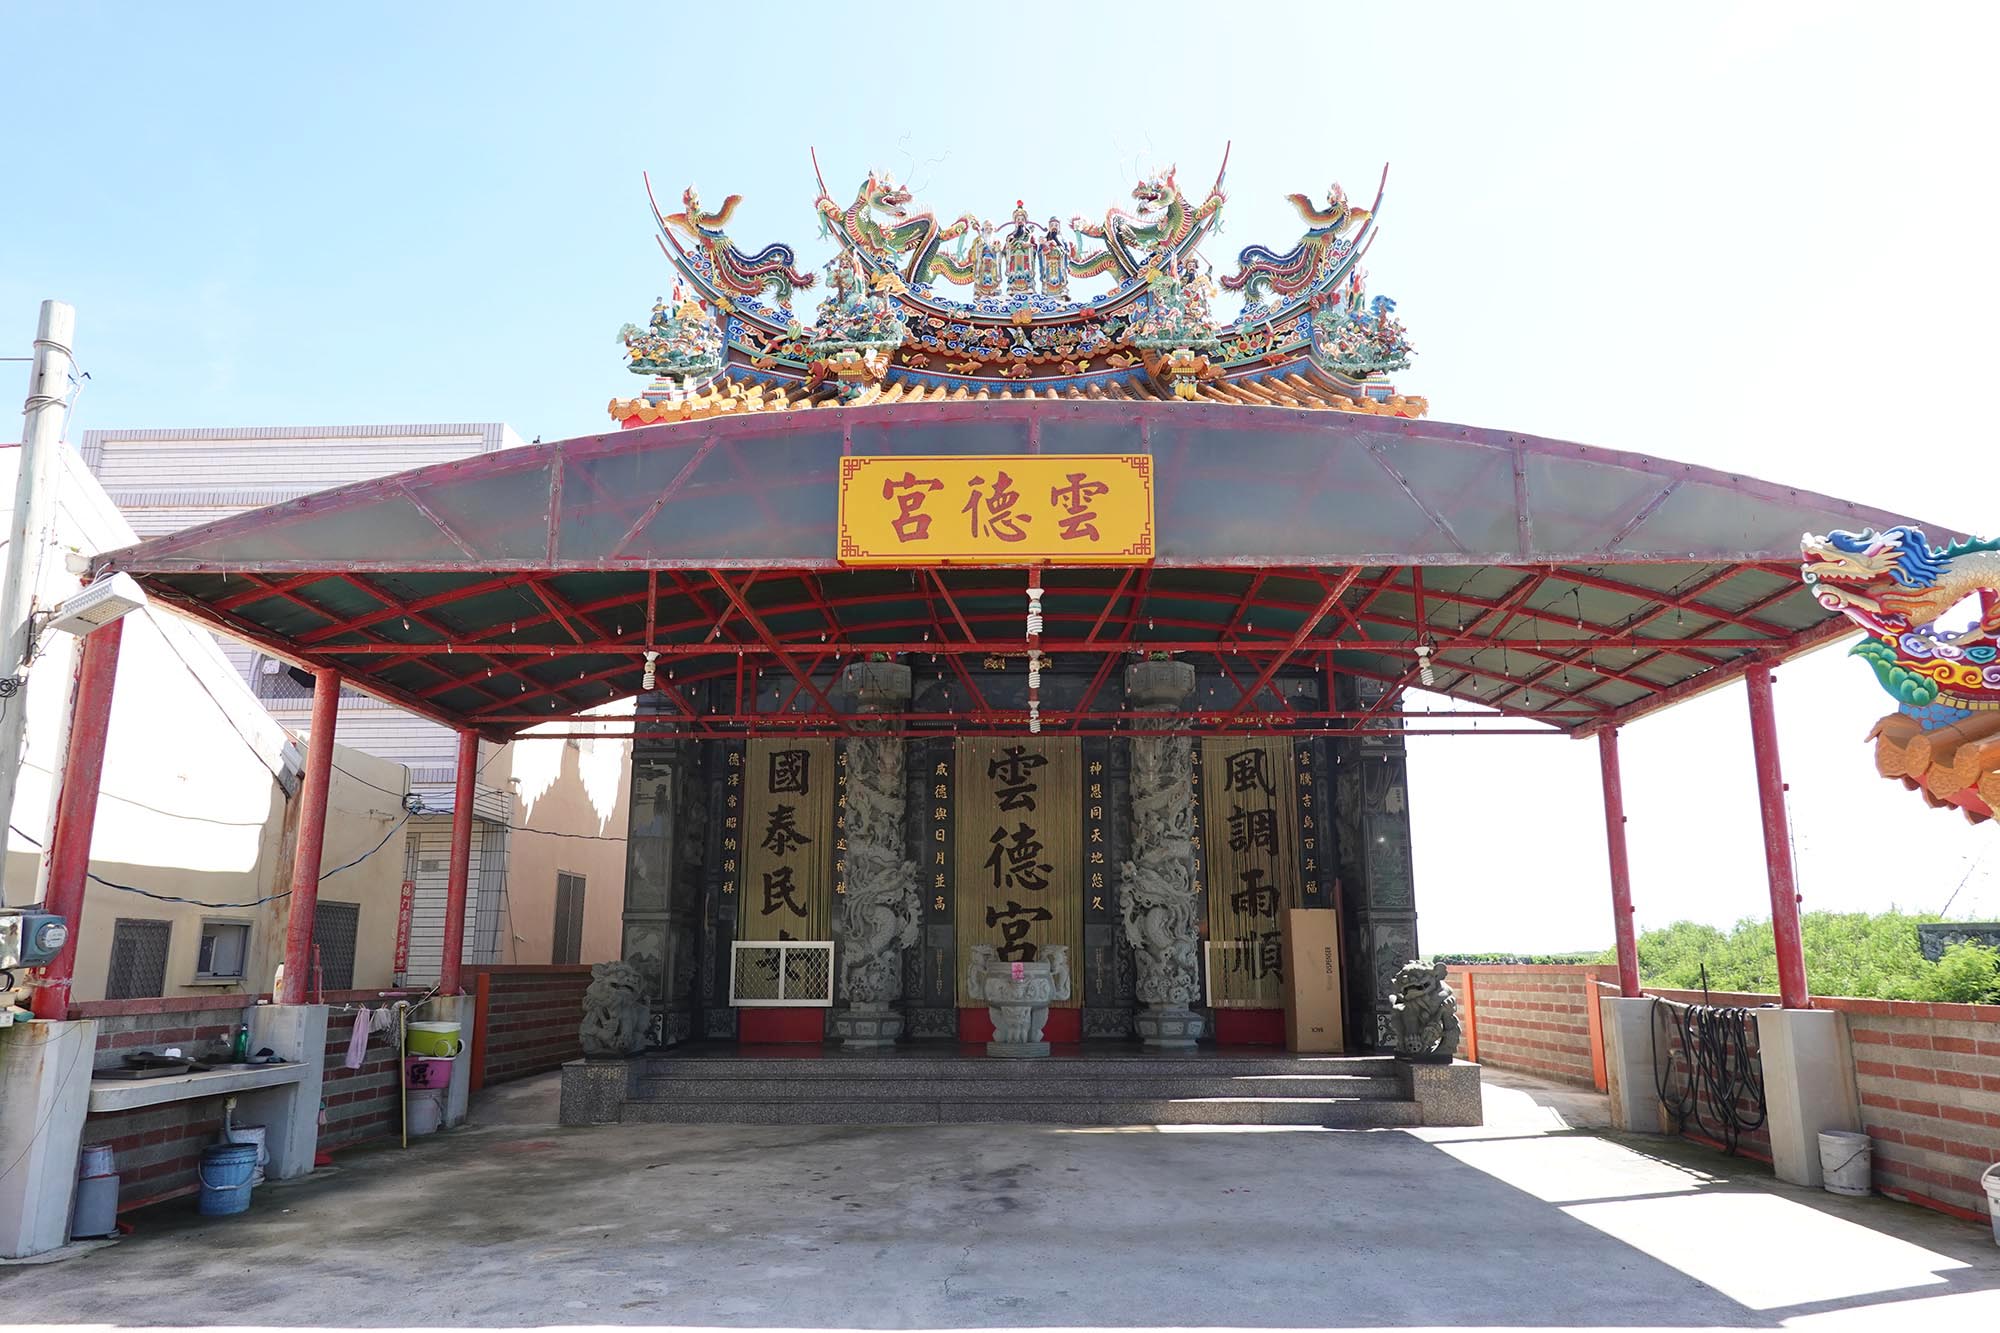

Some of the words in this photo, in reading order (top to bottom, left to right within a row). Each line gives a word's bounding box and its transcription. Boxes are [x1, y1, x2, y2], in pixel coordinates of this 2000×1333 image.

[984, 745, 1054, 963] 雲德宮
[1089, 761, 1104, 910] 神恩同天地悠久
[1224, 748, 1285, 984] 風調雨順
